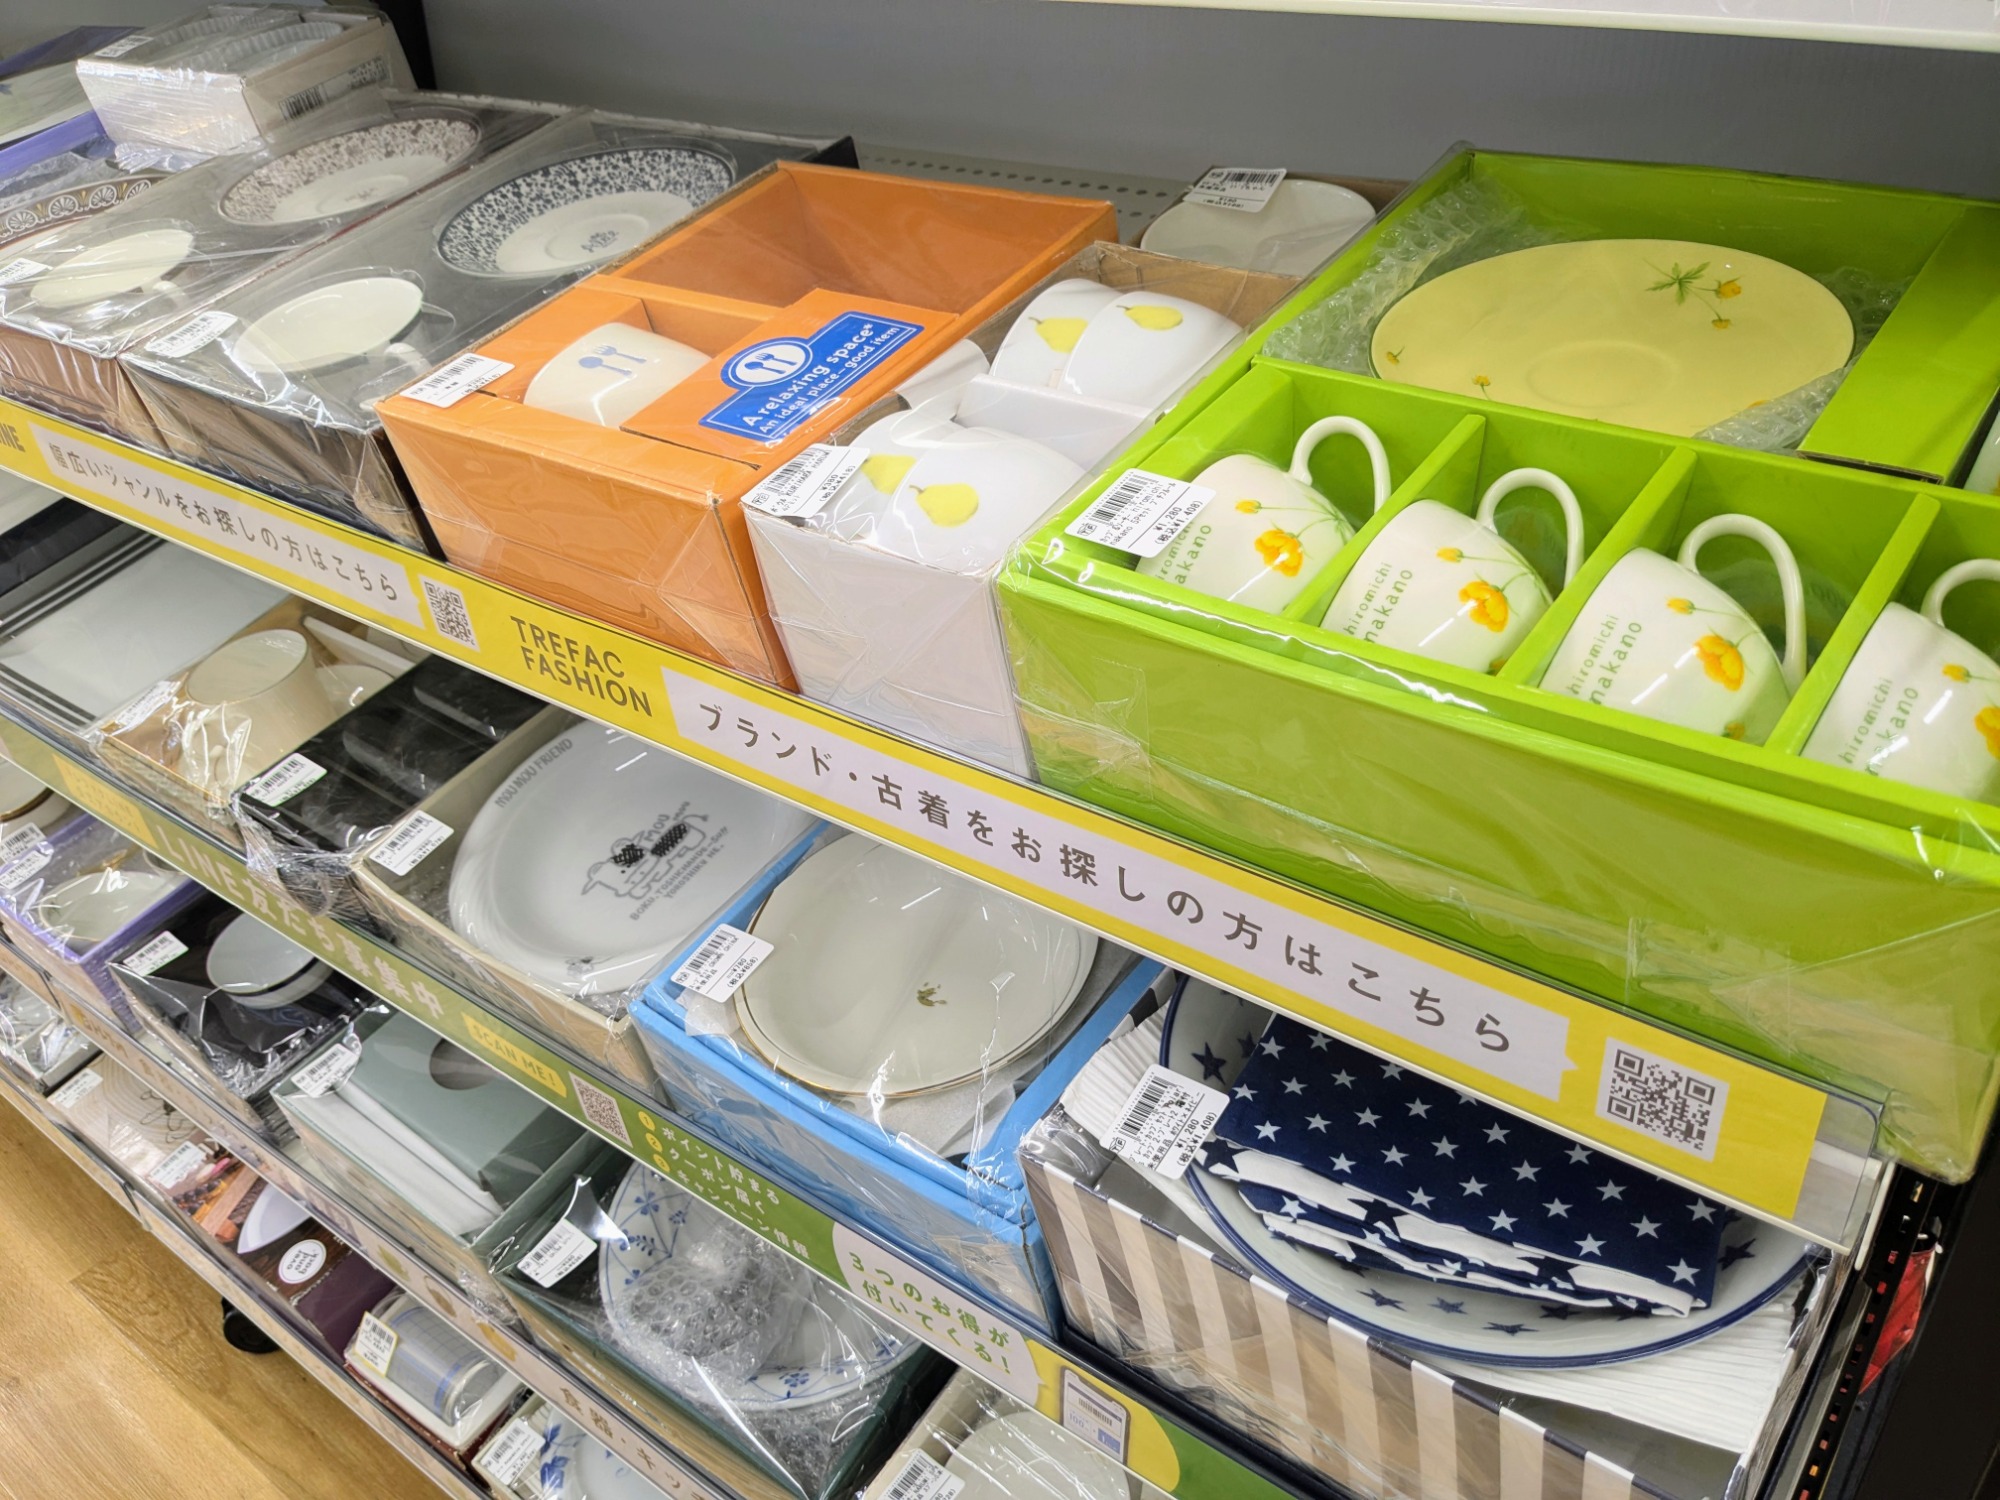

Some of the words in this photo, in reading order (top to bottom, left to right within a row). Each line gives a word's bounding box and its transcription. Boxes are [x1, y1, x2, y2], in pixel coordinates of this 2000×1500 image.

[741, 415, 762, 427] A
[758, 365, 831, 415] relaxing
[759, 419, 779, 433] An
[776, 397, 808, 421] ideal
[869, 327, 899, 347] item
[818, 473, 838, 489] ¥380
[49, 442, 398, 601] 幅広いジャンルをお探しの方はこちら
[1109, 525, 1134, 546] nakano
[1343, 561, 1393, 636] hiromichi
[510, 615, 626, 679] TREFAC
[520, 646, 653, 718] FASHION
[1567, 614, 1619, 695] hiromichi
[1591, 621, 1643, 706] nakano
[1839, 677, 1893, 764] hiromichi
[513, 764, 538, 788] MOU
[534, 737, 573, 770] FRIEND
[643, 812, 671, 842] MOU
[698, 702, 1511, 1053] ブランド・古着をお探しの方はこちら
[156, 825, 445, 1020] LINE友だち募集中
[472, 1024, 518, 1062] SCAN
[661, 1126, 780, 1205] ポイント貯まる
[1146, 1137, 1173, 1170] 未使用品
[1173, 1117, 1200, 1149] ¥1,280
[669, 1148, 765, 1215] クーポン届く
[676, 1170, 810, 1260] キャンペーン情報
[849, 1252, 1010, 1348] 3つのお得が
